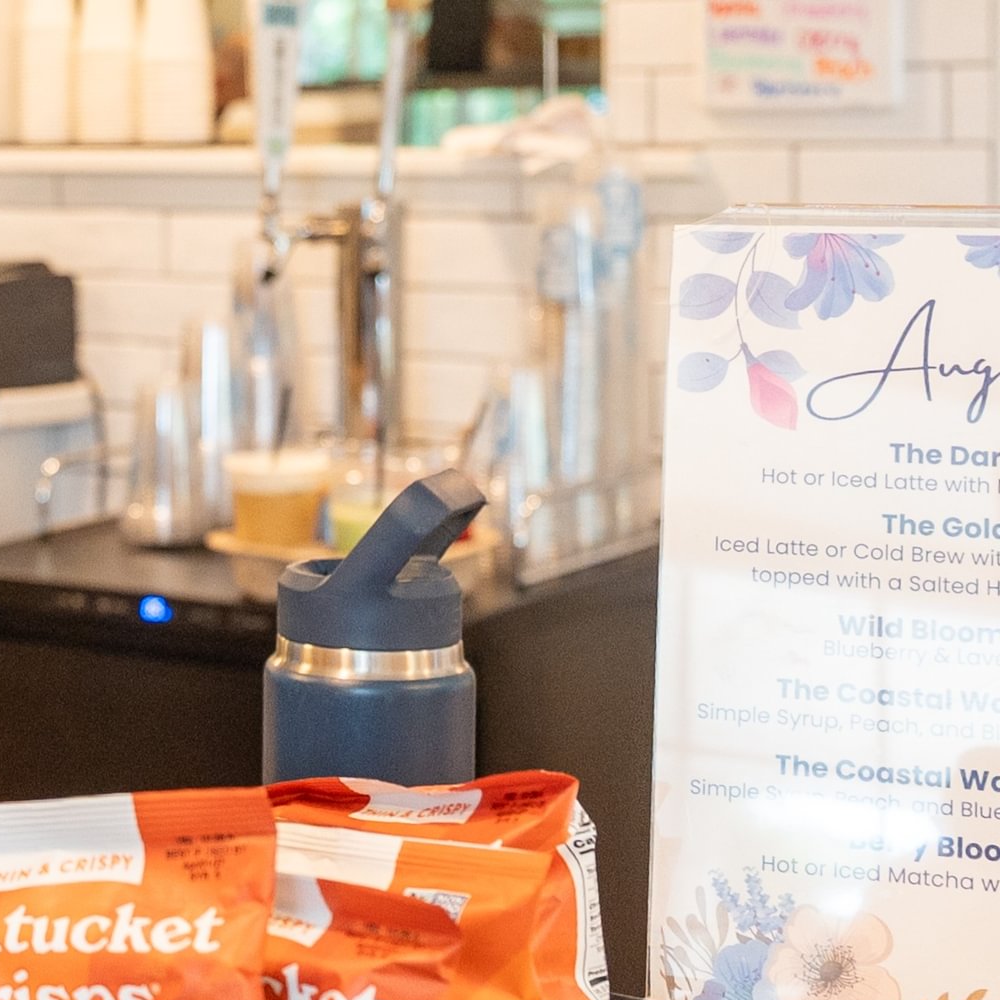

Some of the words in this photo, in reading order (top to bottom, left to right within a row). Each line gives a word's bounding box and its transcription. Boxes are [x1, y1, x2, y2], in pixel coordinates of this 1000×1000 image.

[889, 443, 942, 465] The
[762, 468, 798, 485] Hot
[804, 473, 825, 487] or
[832, 471, 878, 489] Iced
[885, 473, 938, 491] Latte
[945, 476, 990, 494] with
[882, 514, 935, 536] The
[715, 536, 760, 554] Iced
[767, 538, 819, 558] Latte
[826, 544, 848, 558] or
[854, 542, 905, 561] Cold
[912, 547, 965, 566] Brew
[752, 566, 830, 589] topped
[837, 571, 881, 590] with
[888, 578, 902, 591] a
[909, 575, 980, 596] Salted
[839, 614, 903, 639] Wild
[824, 640, 926, 666] Blueberry
[777, 678, 829, 701] The
[837, 682, 952, 711] Coastal
[697, 703, 770, 728] Simple
[777, 709, 843, 733] Syrup,
[850, 715, 923, 738] Peach,
[929, 719, 974, 739] and
[776, 754, 829, 778] The
[836, 759, 951, 789] Coastal
[690, 779, 759, 803] Simple
[59, 854, 134, 874] CRISPY
[762, 855, 798, 875] Hot
[804, 862, 825, 877] or
[834, 862, 880, 882] Iced
[888, 866, 974, 890] Matcha
